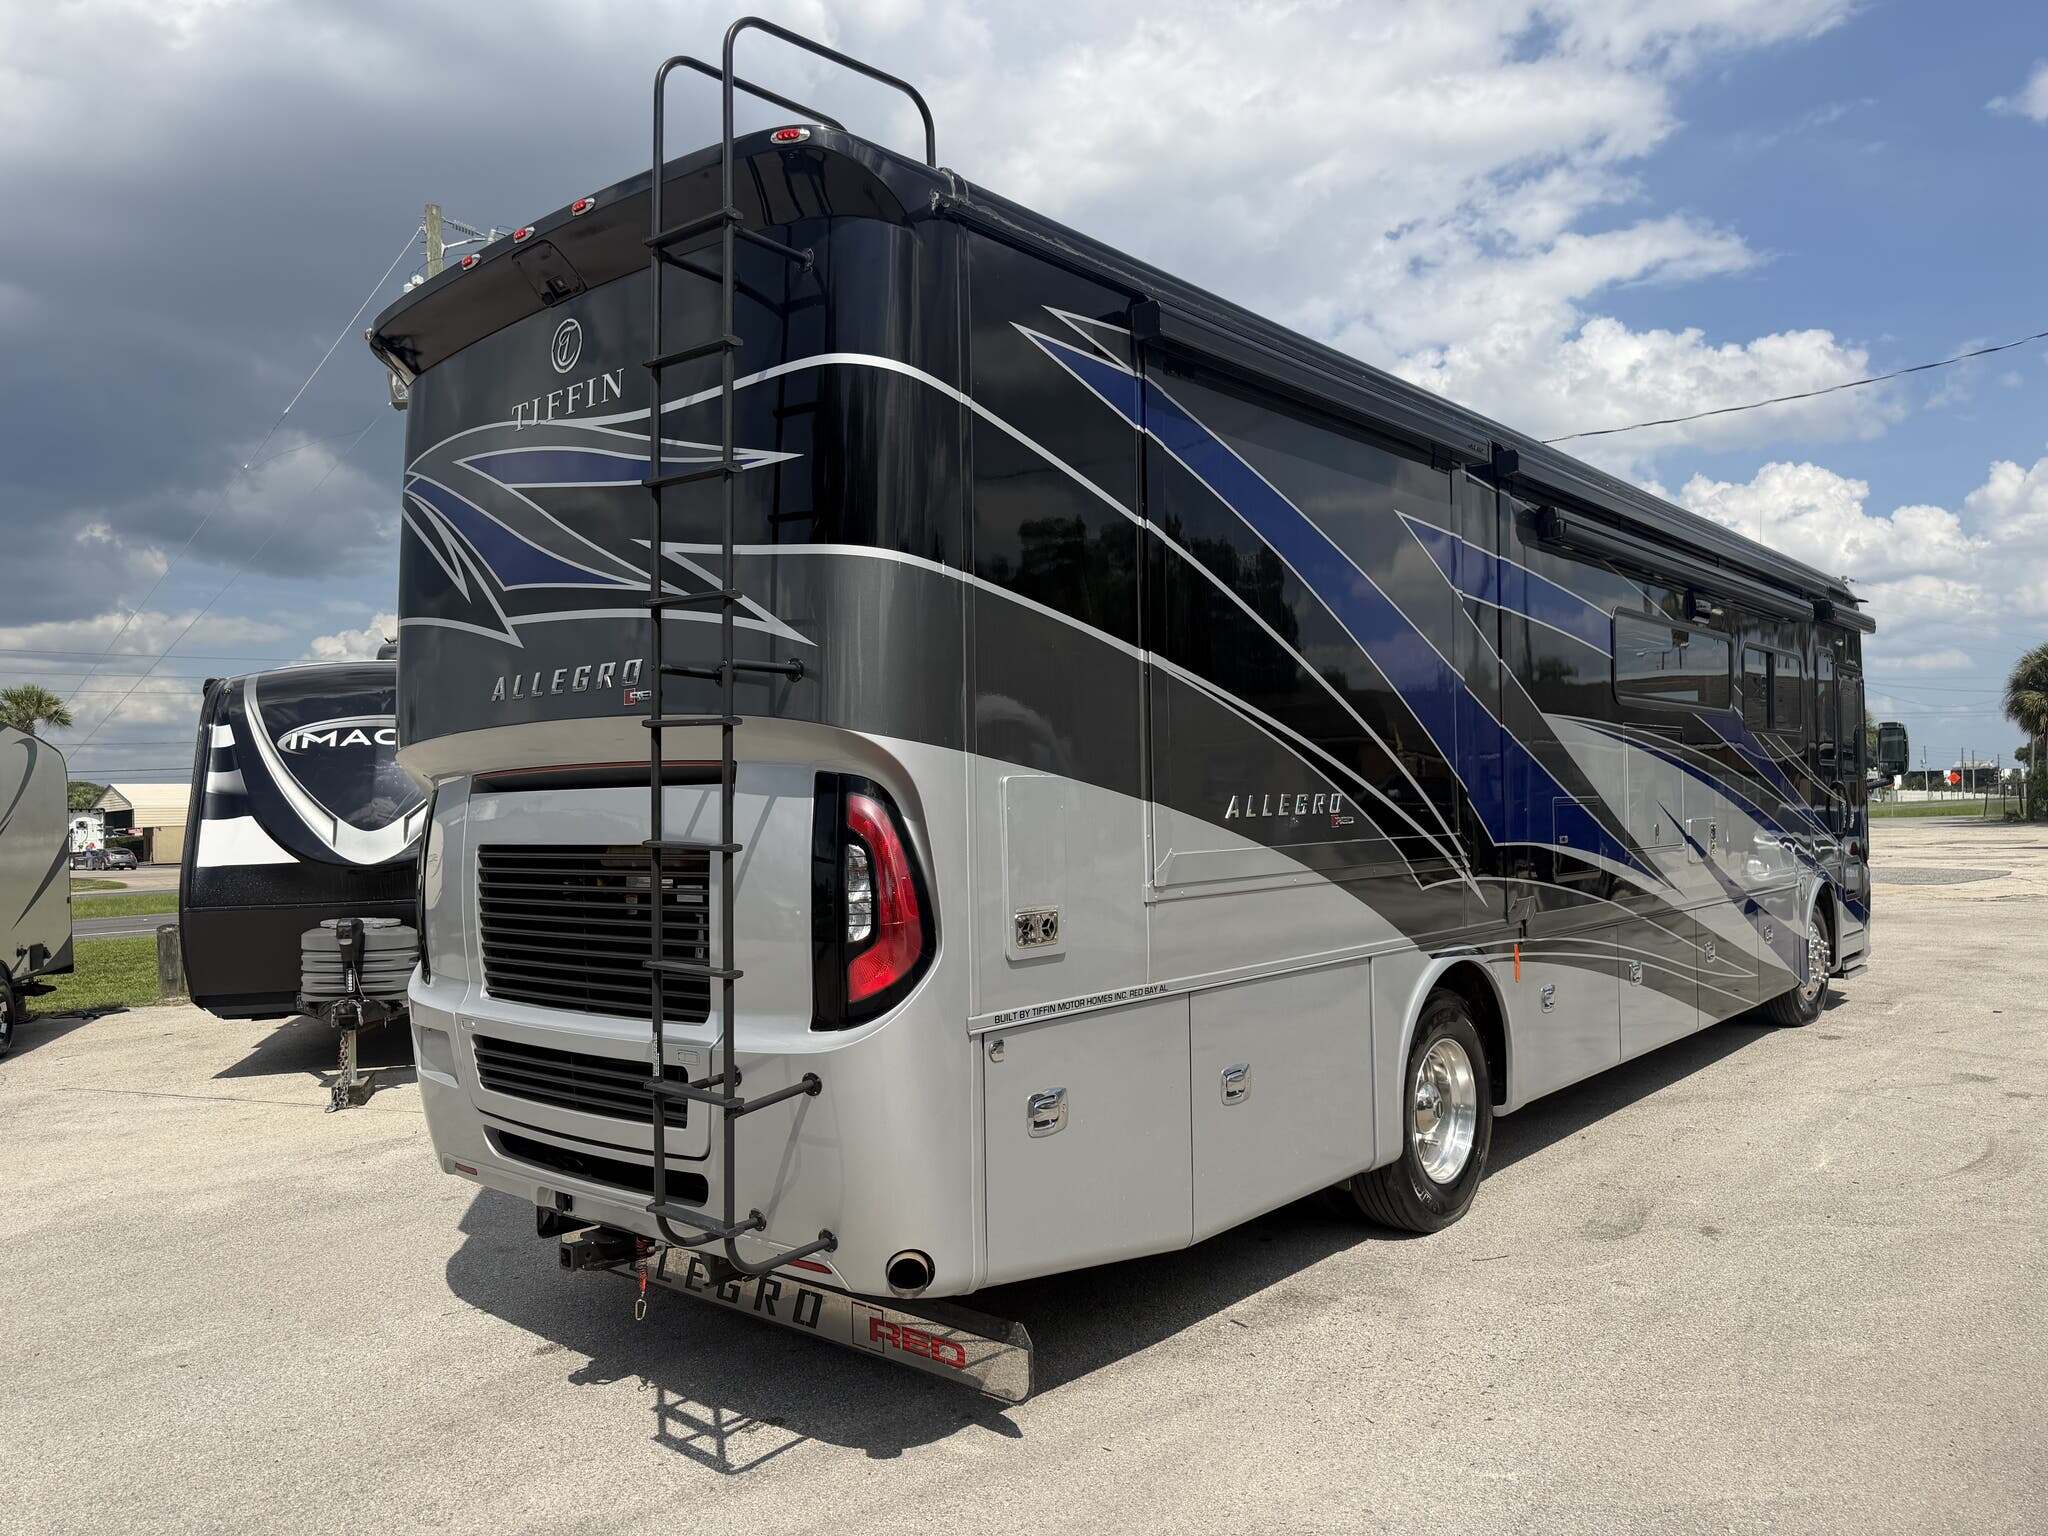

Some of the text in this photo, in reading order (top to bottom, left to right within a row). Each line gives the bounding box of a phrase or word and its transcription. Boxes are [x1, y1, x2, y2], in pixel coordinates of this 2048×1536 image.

[511, 368, 624, 432] TIFFIN
[491, 658, 643, 703] ALLEGRO
[1225, 793, 1342, 819] ALLEGRO
[994, 1011, 1018, 1024] BUILT
[1019, 1008, 1031, 1019] BY
[1032, 1004, 1056, 1016] TIFFIN
[1058, 999, 1085, 1011] MOTOR
[1086, 994, 1113, 1005] HOMES
[1130, 988, 1143, 998] RED
[1144, 985, 1158, 995] BAY
[869, 1316, 966, 1370] RED
